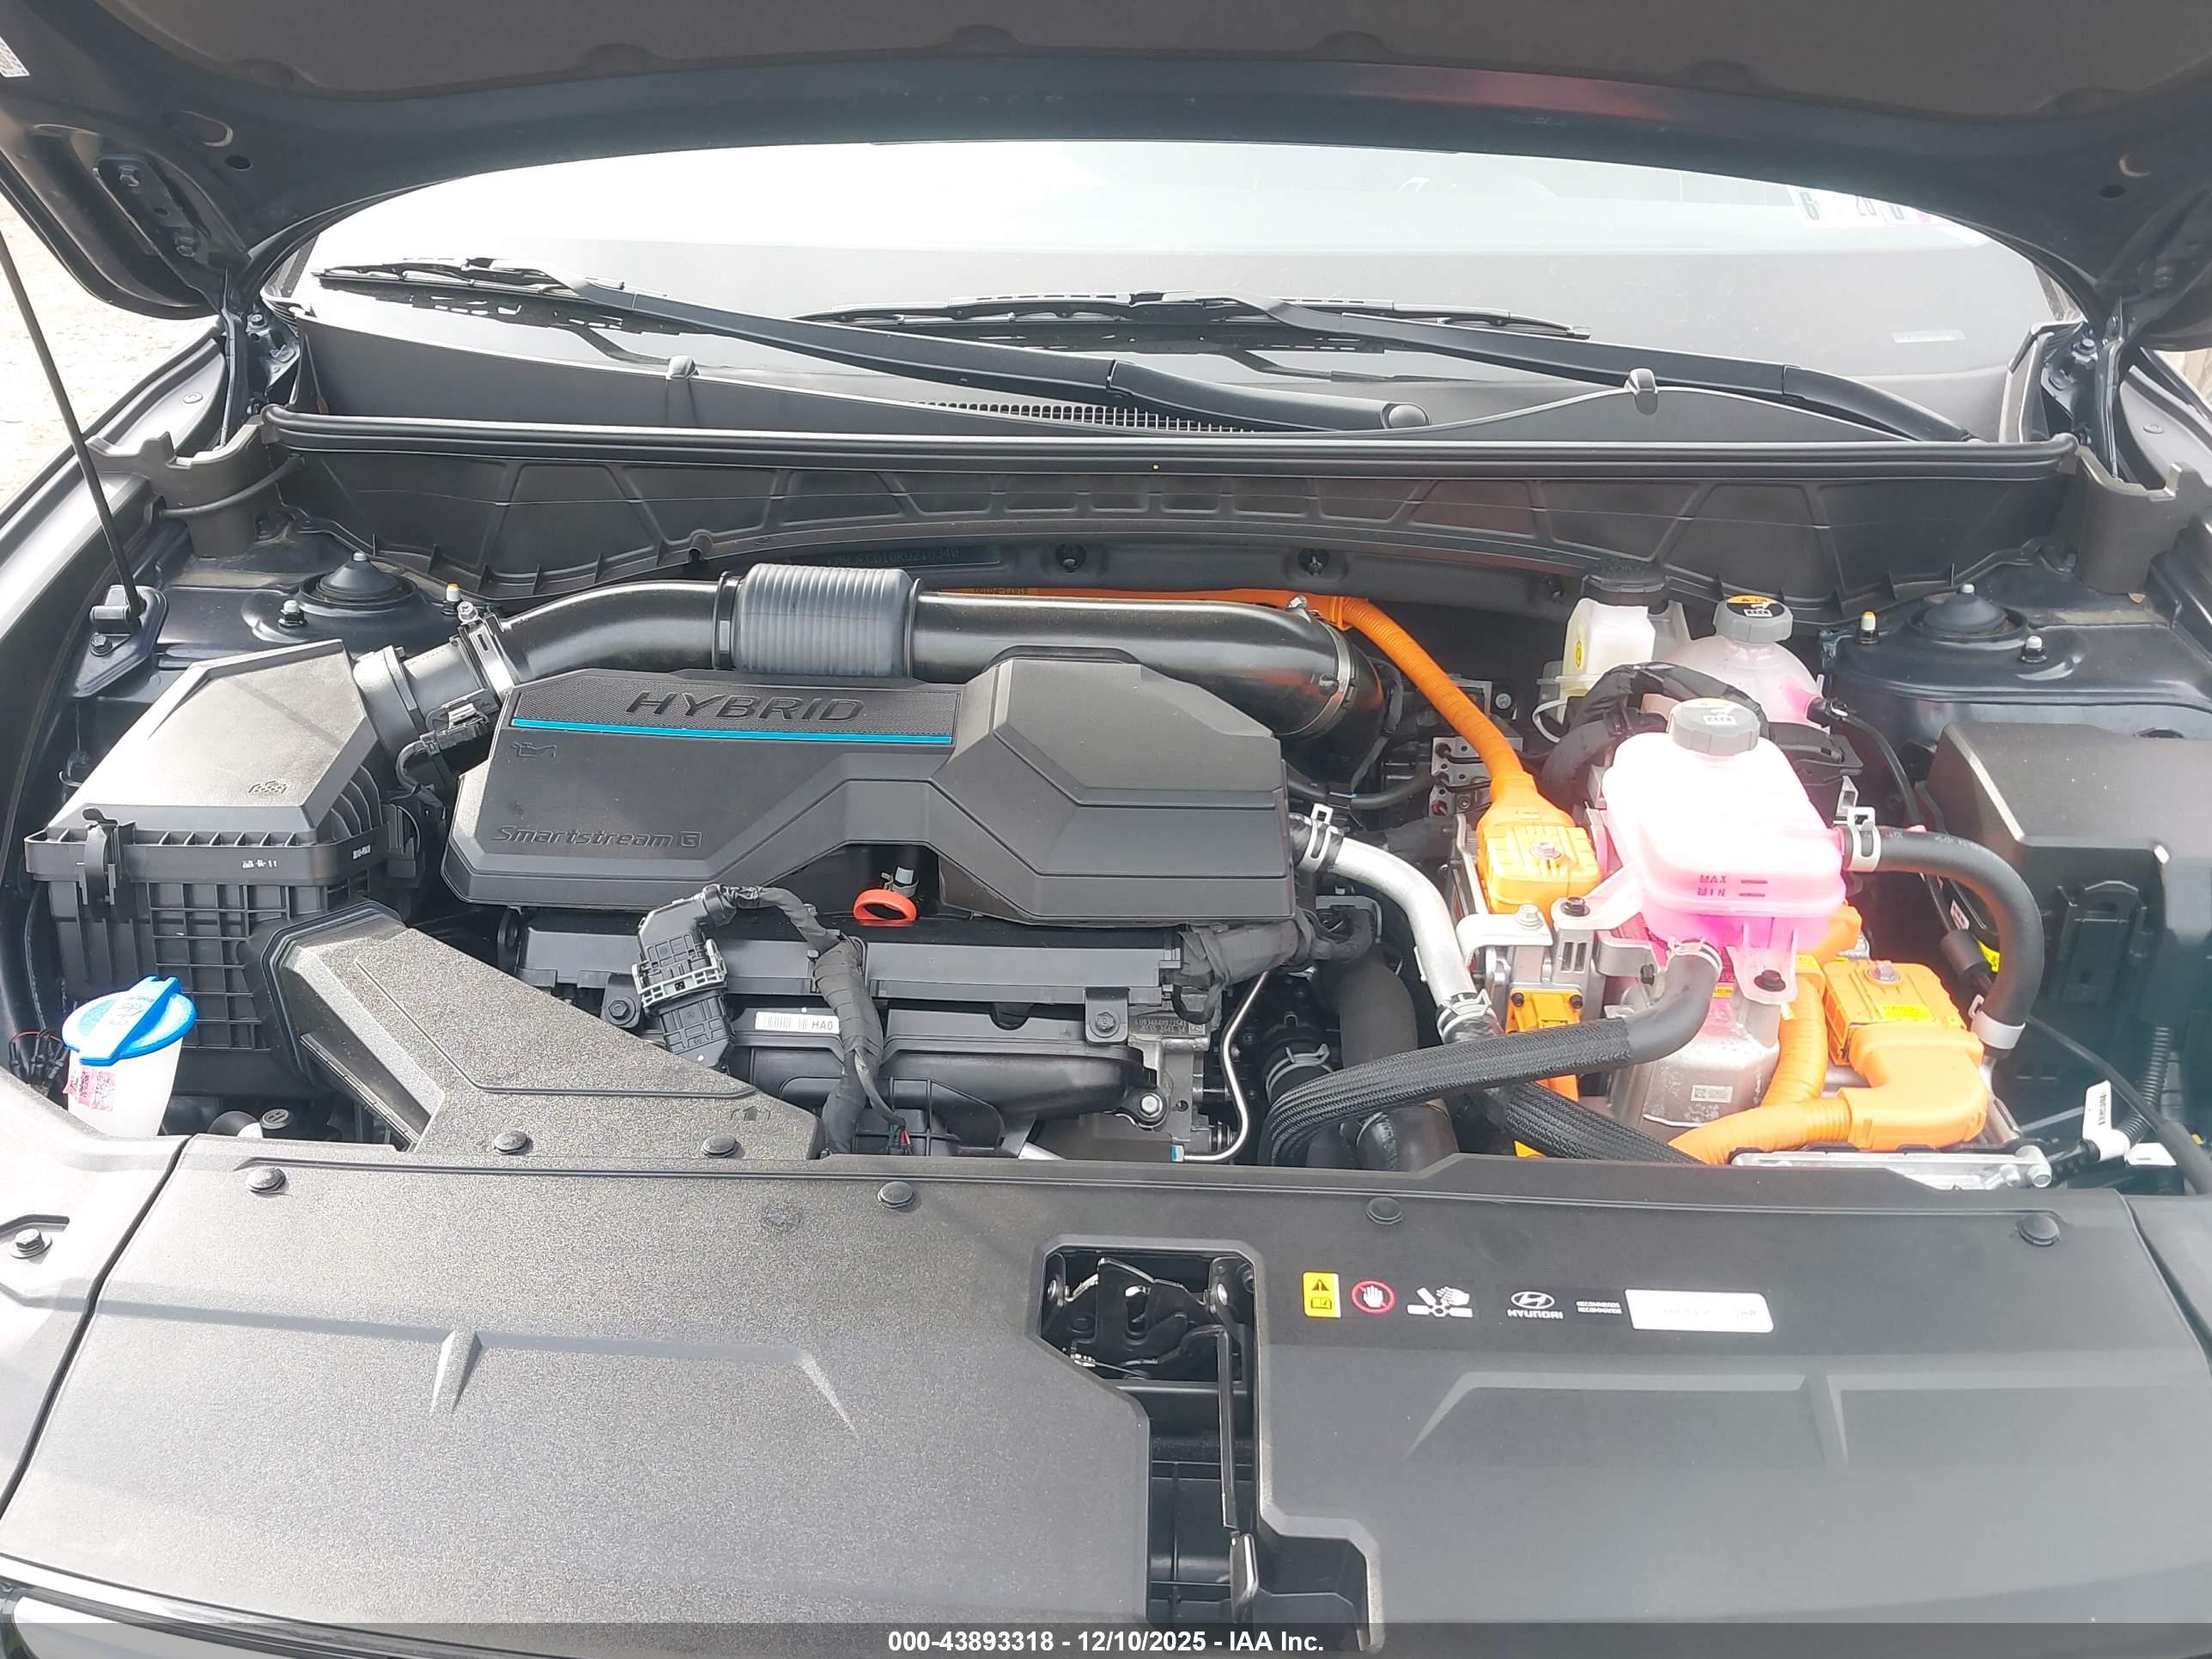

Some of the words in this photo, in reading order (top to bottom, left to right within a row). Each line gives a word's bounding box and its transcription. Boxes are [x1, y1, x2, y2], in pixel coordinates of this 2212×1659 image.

[625, 690, 866, 723] HYBRID
[491, 824, 675, 848] Smartstream
[1700, 875, 1727, 884] MAX
[1698, 888, 1725, 896] MIN
[1507, 1309, 1564, 1320] HYUNDAI
